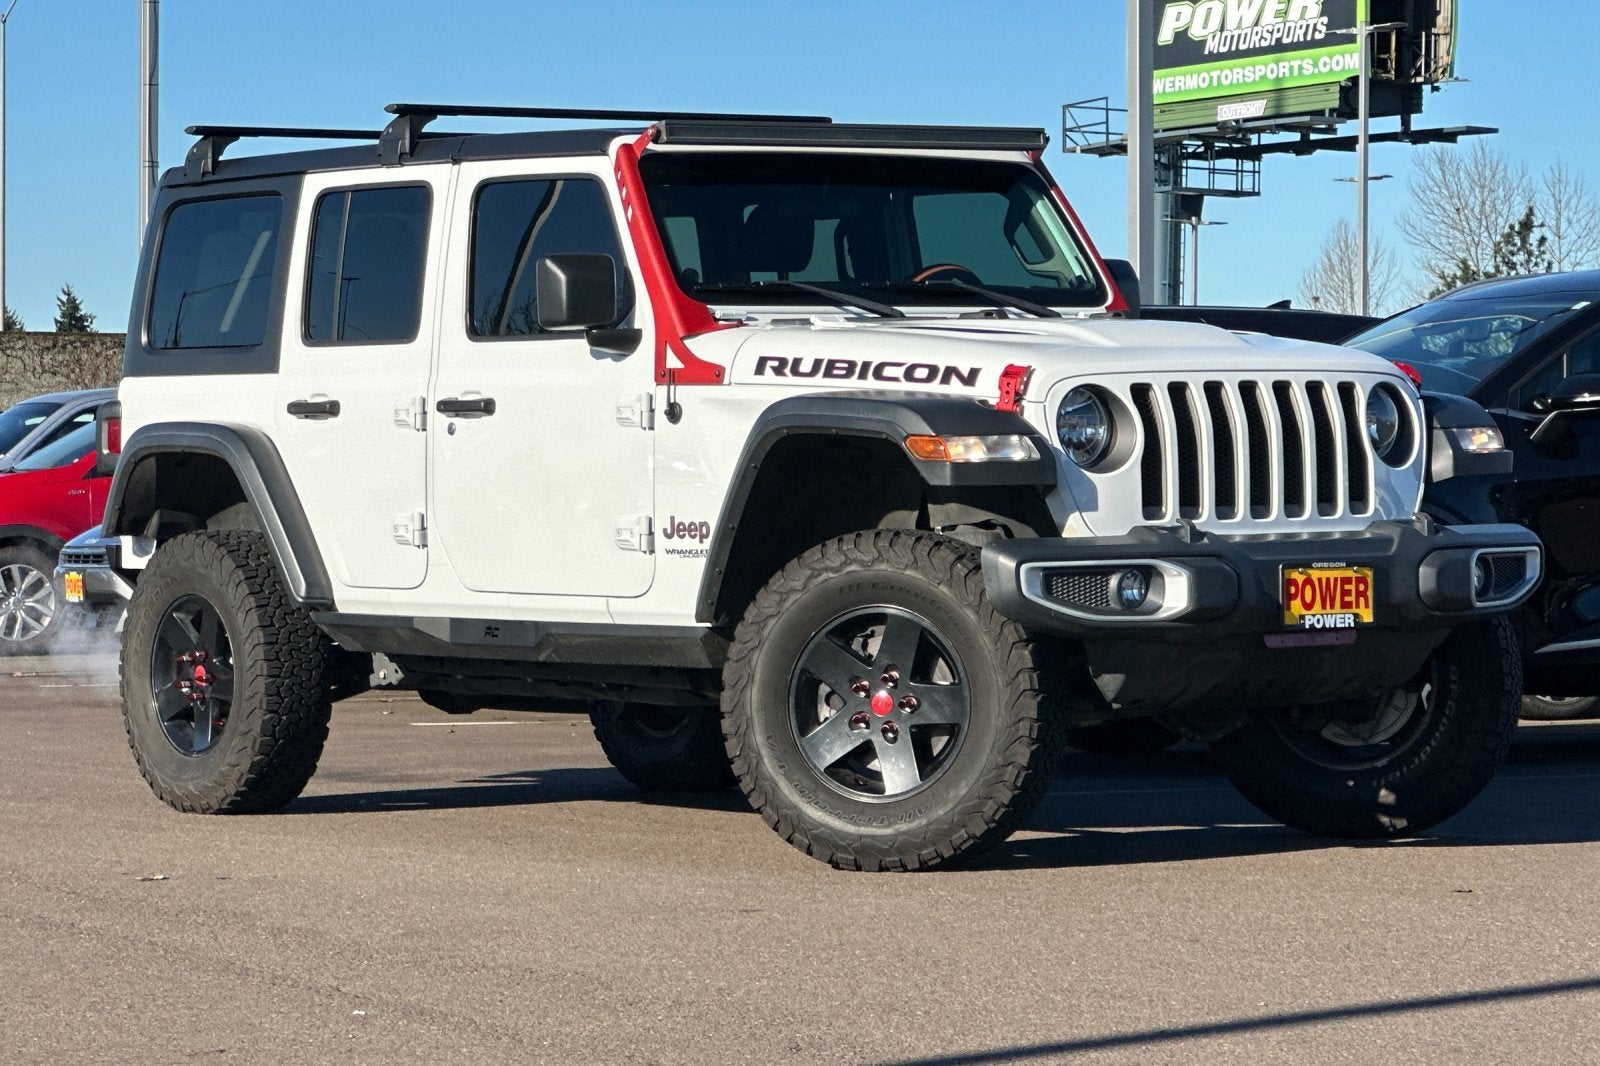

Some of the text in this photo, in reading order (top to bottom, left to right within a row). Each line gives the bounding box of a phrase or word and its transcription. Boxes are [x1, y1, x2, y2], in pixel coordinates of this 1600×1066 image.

[1158, 0, 1322, 45] POWER
[1204, 16, 1328, 55] MOTORSPORTS
[753, 355, 983, 387] RUBICON
[662, 515, 711, 544] Jeep
[1285, 576, 1370, 611] POWER
[1305, 614, 1355, 629] POWER
